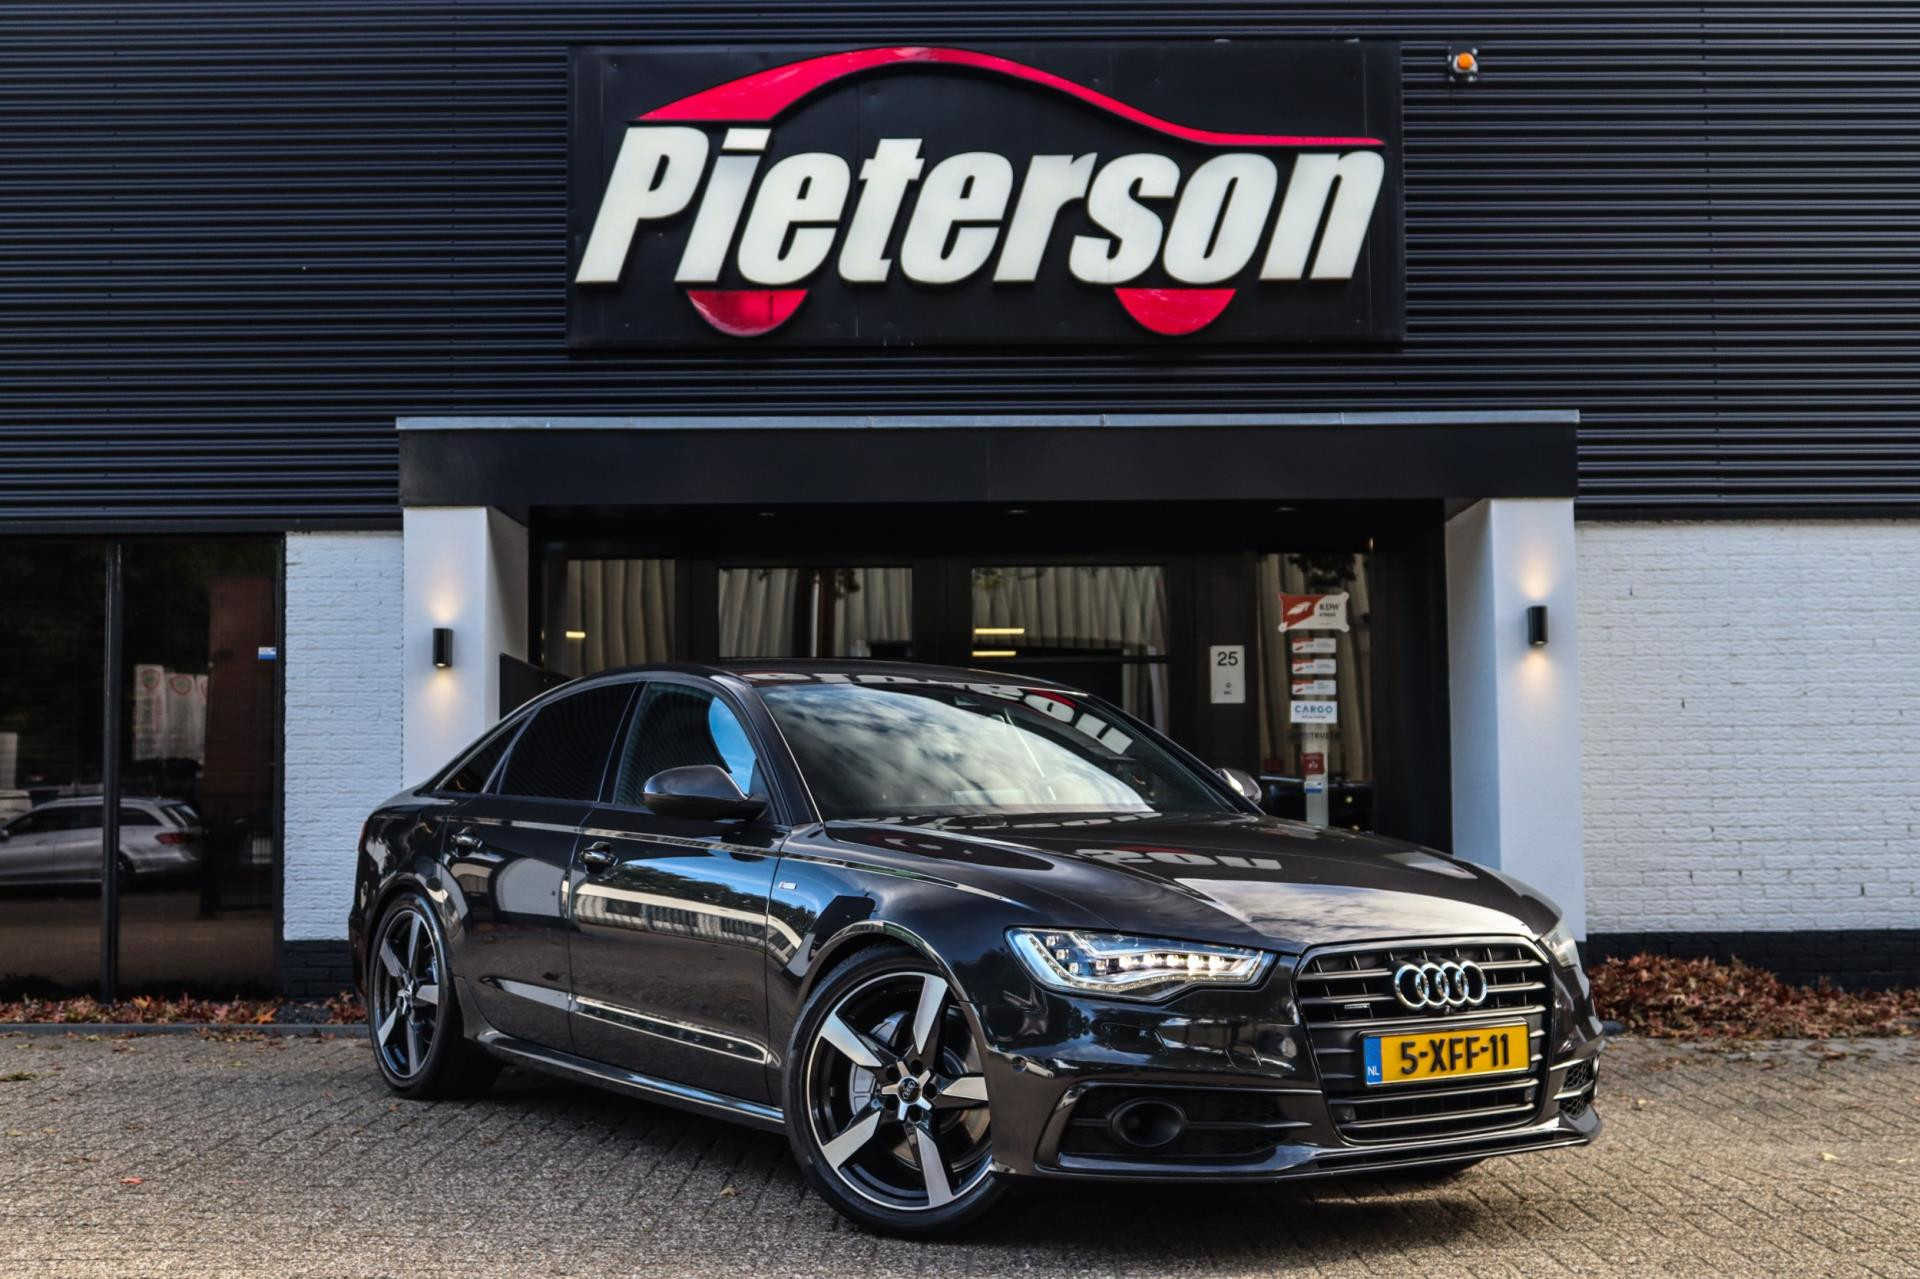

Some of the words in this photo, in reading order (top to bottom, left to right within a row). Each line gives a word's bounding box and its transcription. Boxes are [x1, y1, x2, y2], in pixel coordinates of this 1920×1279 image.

[575, 125, 1385, 285] Pieterson
[1217, 651, 1238, 666] 25
[1295, 705, 1333, 713] CARGO
[1367, 1066, 1380, 1076] NL
[1400, 1033, 1510, 1075] 5-XFF-11
